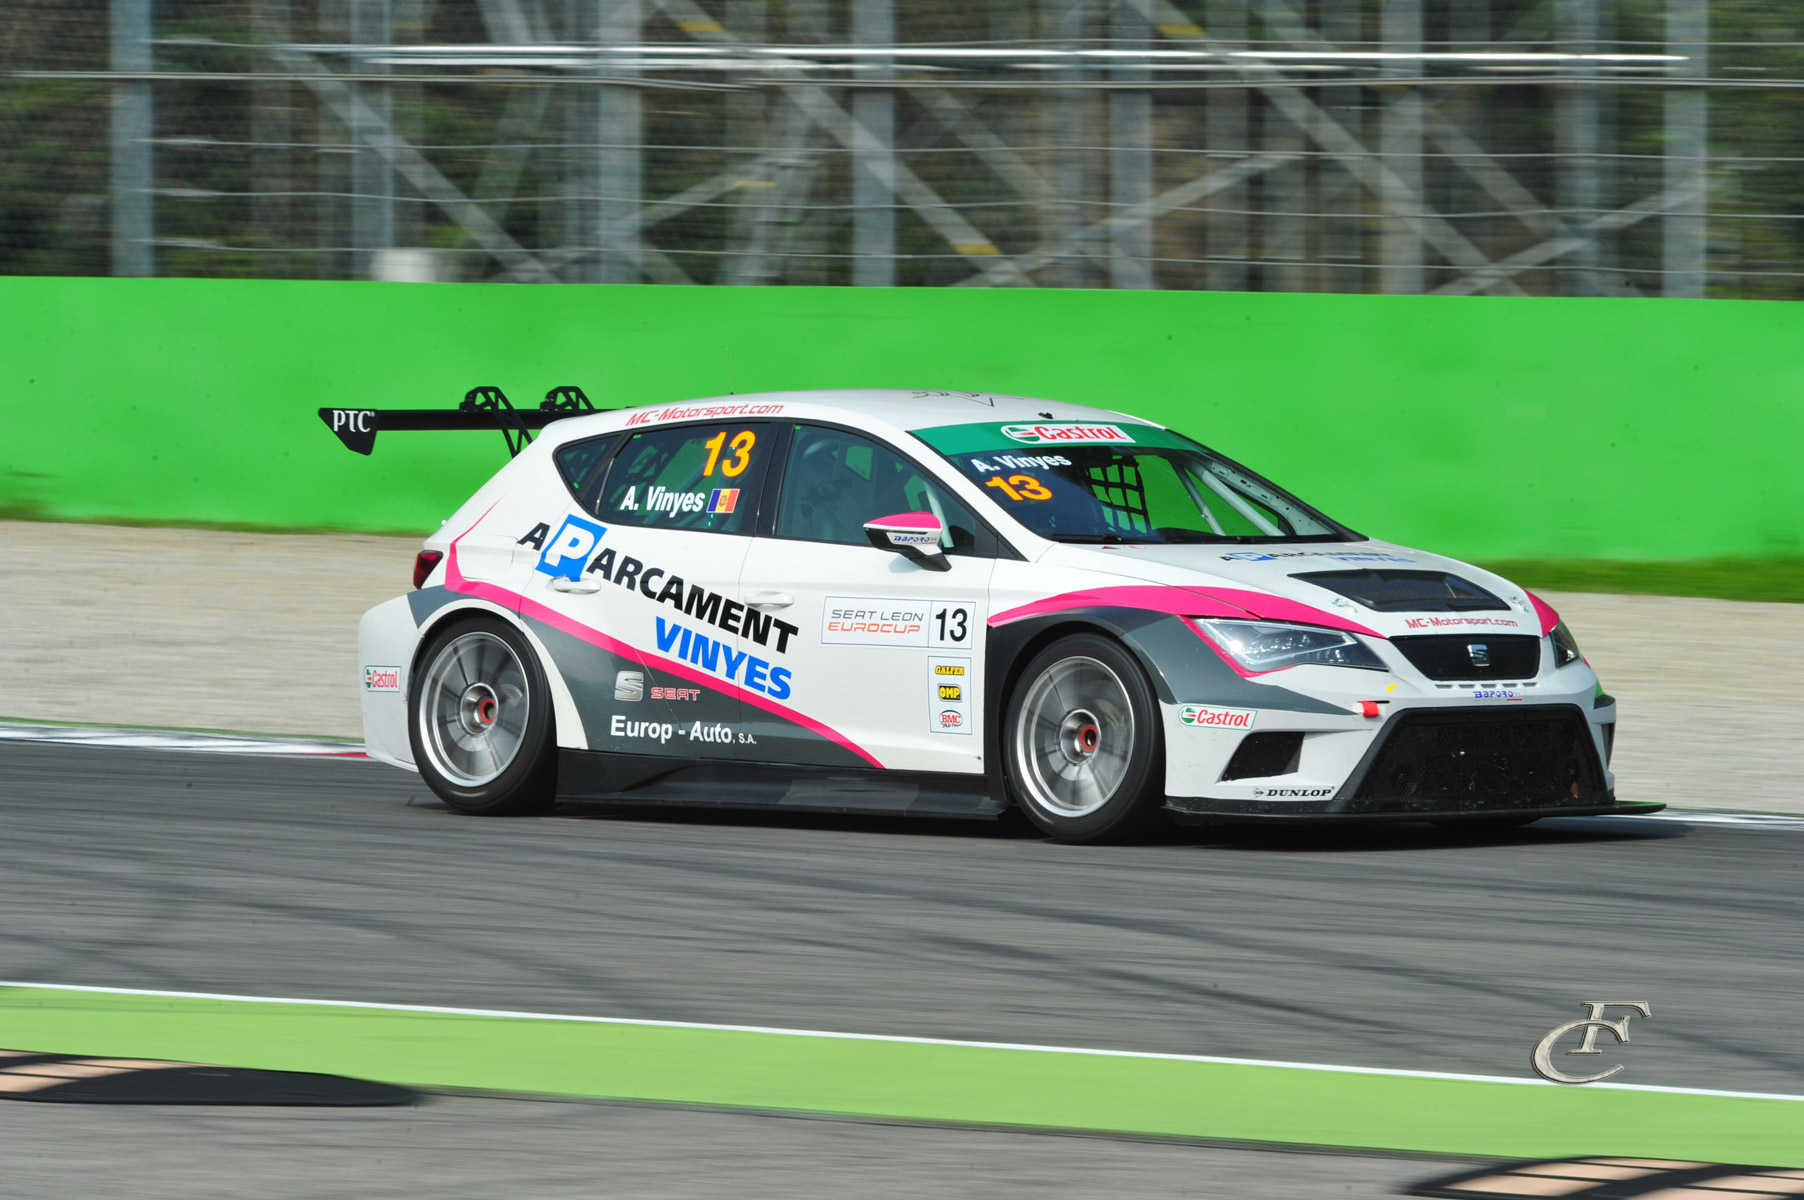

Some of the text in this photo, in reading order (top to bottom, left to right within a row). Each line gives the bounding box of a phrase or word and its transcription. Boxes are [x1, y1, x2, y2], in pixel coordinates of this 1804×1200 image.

[625, 404, 784, 427] MC-Motorsport.com
[1034, 426, 1127, 440] Castrol
[703, 430, 756, 478] 13
[971, 455, 1072, 473] A. Vinyes
[985, 474, 1053, 501] 13
[620, 486, 706, 518] A. Vinyes
[517, 521, 799, 654] APARCAMENT
[831, 609, 924, 622] SEAT LEON
[1405, 617, 1518, 629] MC-Motorsport.com
[827, 622, 921, 634] EUROCUP
[935, 608, 968, 642] 13
[655, 616, 792, 700] VINYES
[372, 670, 398, 688] Castrol
[935, 665, 965, 676] GALFER
[651, 687, 701, 701] SEAT
[939, 686, 961, 699] OMP
[941, 714, 961, 724] BMC
[1196, 709, 1251, 727] Castrol
[610, 715, 673, 744] Europ
[738, 732, 757, 744] S.A.
[1266, 789, 1332, 797] DUNLOP
